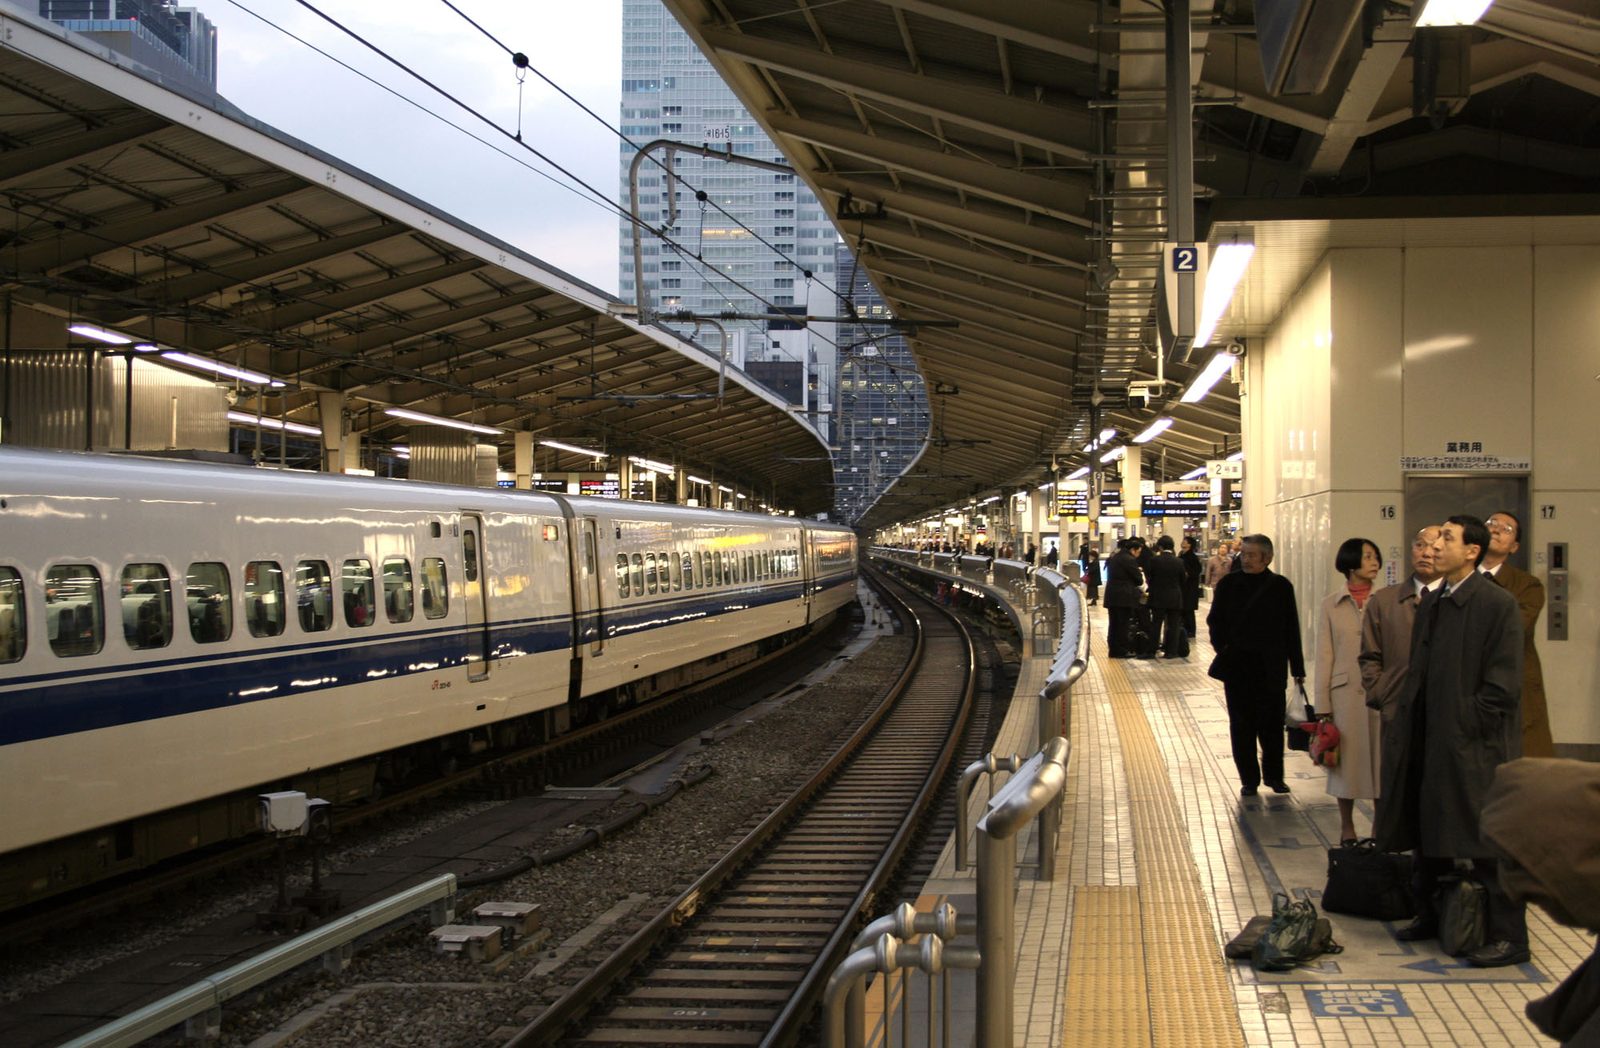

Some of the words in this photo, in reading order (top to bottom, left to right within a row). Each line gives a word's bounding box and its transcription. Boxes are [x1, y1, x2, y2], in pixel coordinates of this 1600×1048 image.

[1178, 250, 1193, 269] 2
[1446, 442, 1482, 453] 業務用
[1381, 506, 1395, 518] 16
[1541, 505, 1555, 518] 17
